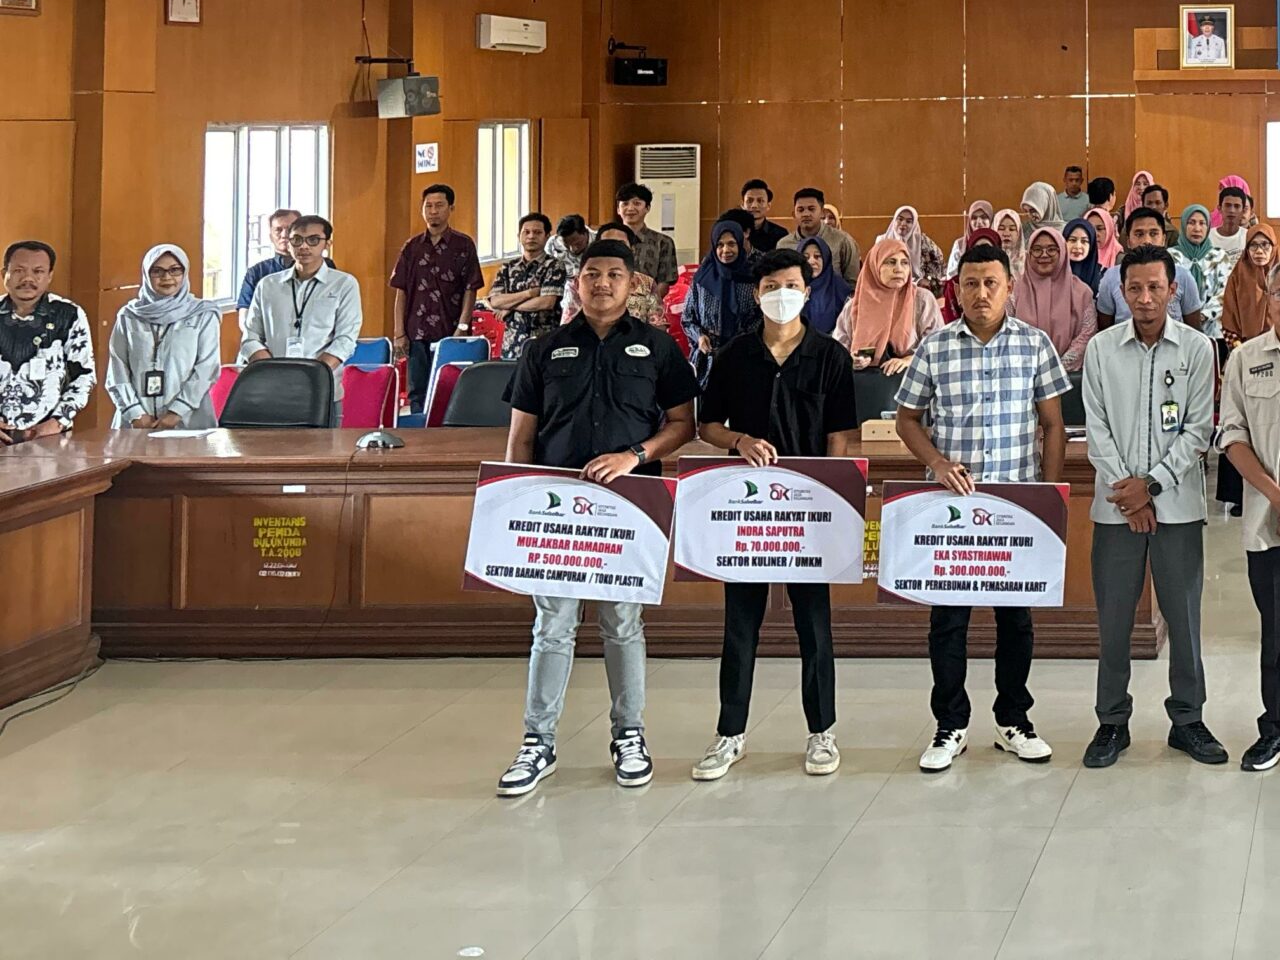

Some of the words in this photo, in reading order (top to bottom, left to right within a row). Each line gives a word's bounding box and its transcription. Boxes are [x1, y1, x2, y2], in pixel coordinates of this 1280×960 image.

[254, 517, 306, 527] INVENTARIS
[711, 510, 742, 521] KREDIT
[744, 511, 772, 522] USAHA
[774, 511, 806, 522] RAKYAT
[509, 520, 542, 532] KREDIT
[543, 522, 573, 535] USAHA
[575, 525, 609, 538] RAKYAT
[737, 526, 763, 536] INDRA
[765, 526, 805, 537] SAPUTRA
[573, 540, 623, 554] RAMADHAN
[735, 541, 749, 553] Rp.
[914, 535, 945, 546] KREDIT
[947, 535, 975, 546] USAHA
[977, 536, 1008, 547] RAKYAT
[716, 556, 750, 567] SEKTOR
[751, 556, 787, 567] KULINER
[795, 557, 822, 568] UMKM
[934, 550, 950, 561] EKA
[952, 550, 1012, 562] SYASTRIAWAN
[485, 565, 514, 577] SEKTOR
[515, 567, 545, 580] BARANG
[546, 569, 587, 582] CAMPURAN
[595, 573, 614, 585] TOKO
[615, 575, 644, 587] PLASTIK
[934, 565, 948, 576] Rp.
[894, 579, 921, 590] SEKTOR
[925, 580, 971, 591] PERKEBUNAN
[972, 581, 979, 591] &
[980, 581, 1023, 592] PEMASARAN
[1024, 581, 1047, 592] KARET
